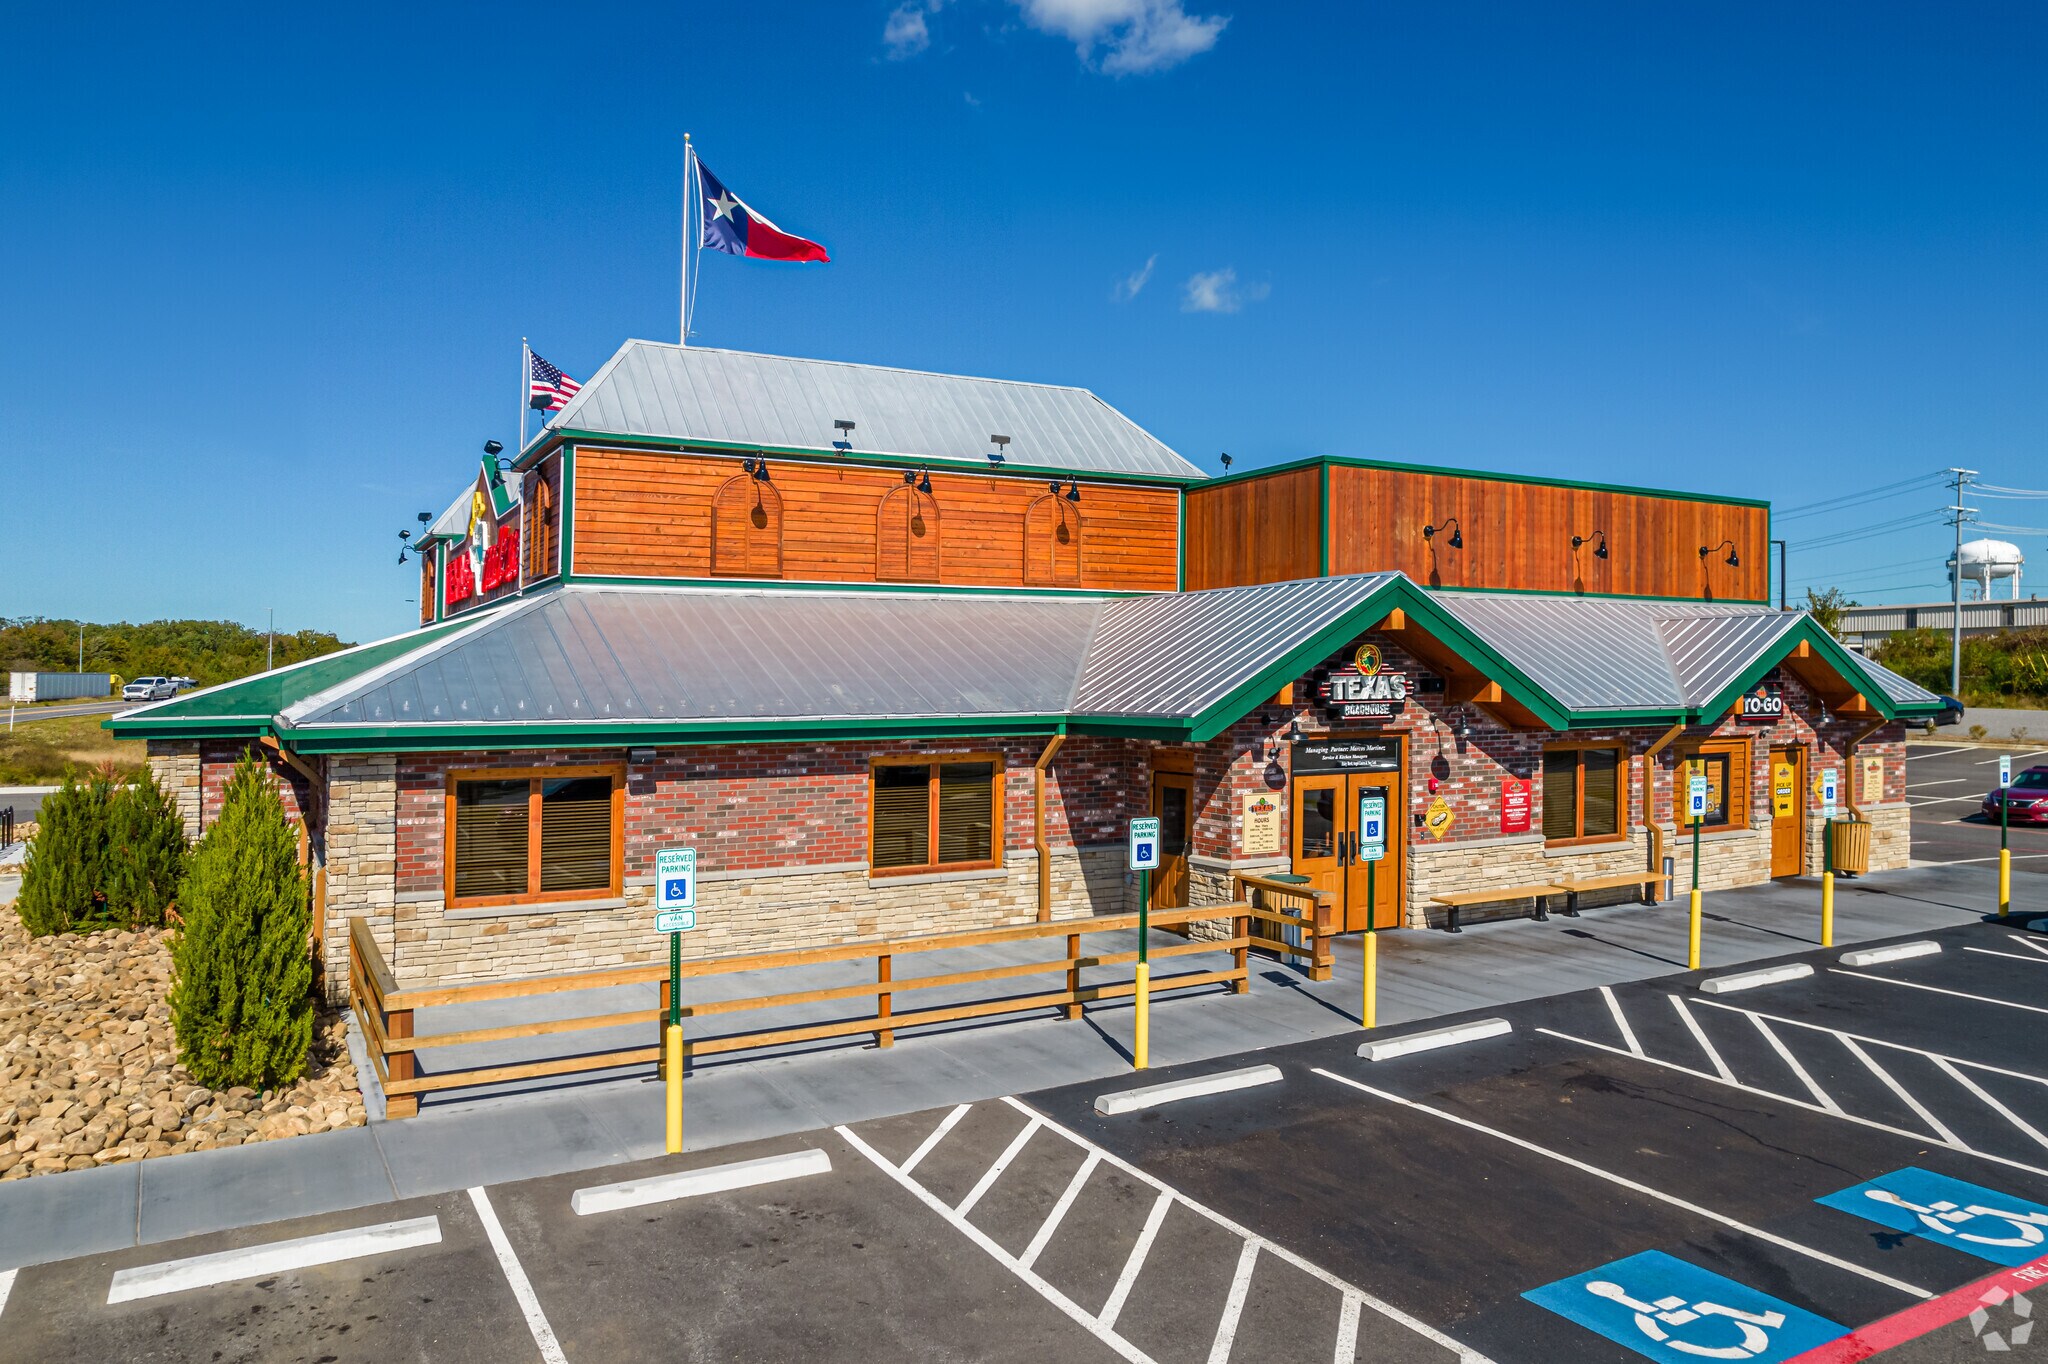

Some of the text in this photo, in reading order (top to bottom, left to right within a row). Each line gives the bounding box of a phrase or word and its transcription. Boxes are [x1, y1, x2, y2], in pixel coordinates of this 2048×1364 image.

[1330, 675, 1406, 700] TEXAS
[1744, 697, 1782, 712] TO-GO
[1252, 804, 1273, 812] TEXAS
[1132, 822, 1158, 830] RESERVED
[659, 854, 693, 864] RESERVED
[662, 864, 691, 873] PARKING
[2012, 1266, 2047, 1282] FIRE
